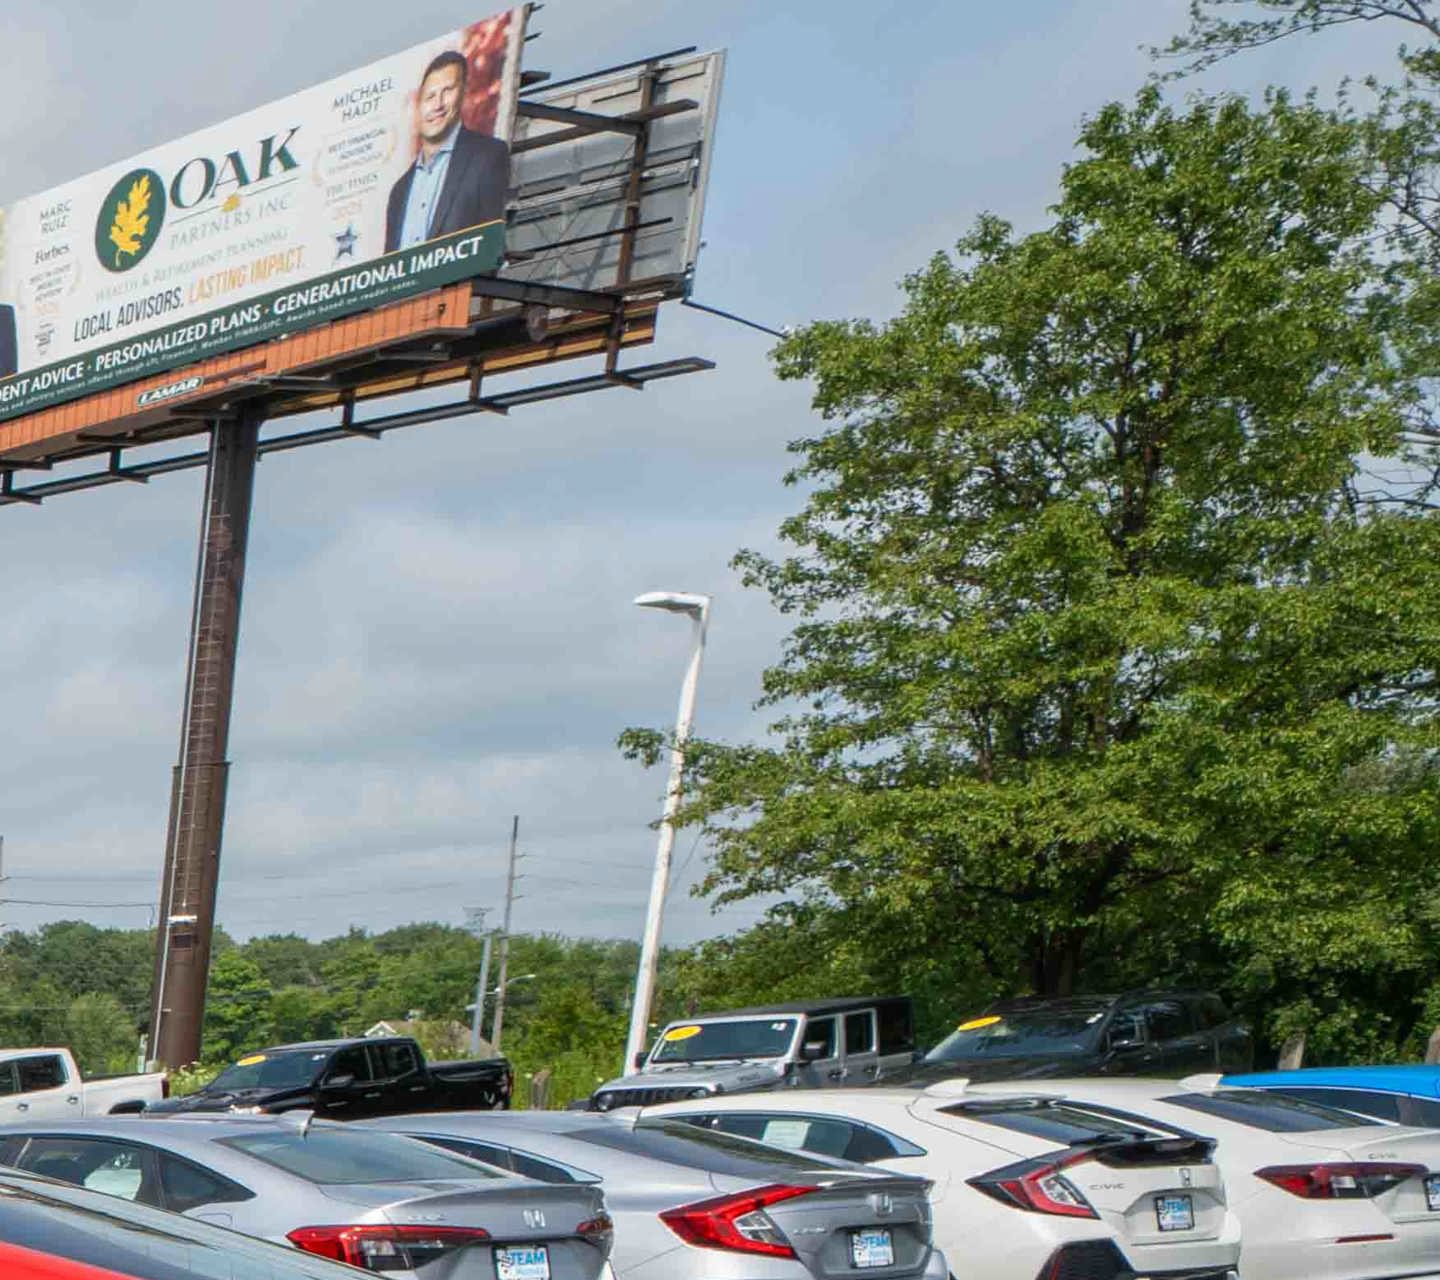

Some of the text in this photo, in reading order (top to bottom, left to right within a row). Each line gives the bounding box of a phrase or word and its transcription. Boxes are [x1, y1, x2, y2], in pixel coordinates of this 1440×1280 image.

[332, 77, 394, 108] MICHAEL
[342, 97, 382, 123] HADT
[169, 126, 302, 209] OAK
[40, 199, 73, 220] MARC
[170, 211, 252, 250] PARTNERS
[258, 194, 292, 219] INC
[34, 243, 70, 264] Forbes
[30, 361, 84, 392] ADVICE
[95, 320, 208, 370] PERSONALIZED
[209, 304, 262, 335] PLANS
[273, 260, 407, 315] GENERATIONAL
[410, 235, 484, 275] IMPACT
[74, 310, 113, 342] LOCAL
[116, 286, 185, 328] ADVISORS.
[188, 266, 248, 304] LASTING
[139, 378, 200, 404] LAMAR
[1089, 1183, 1125, 1191] CIVIC
[511, 1250, 546, 1266] TEAM
